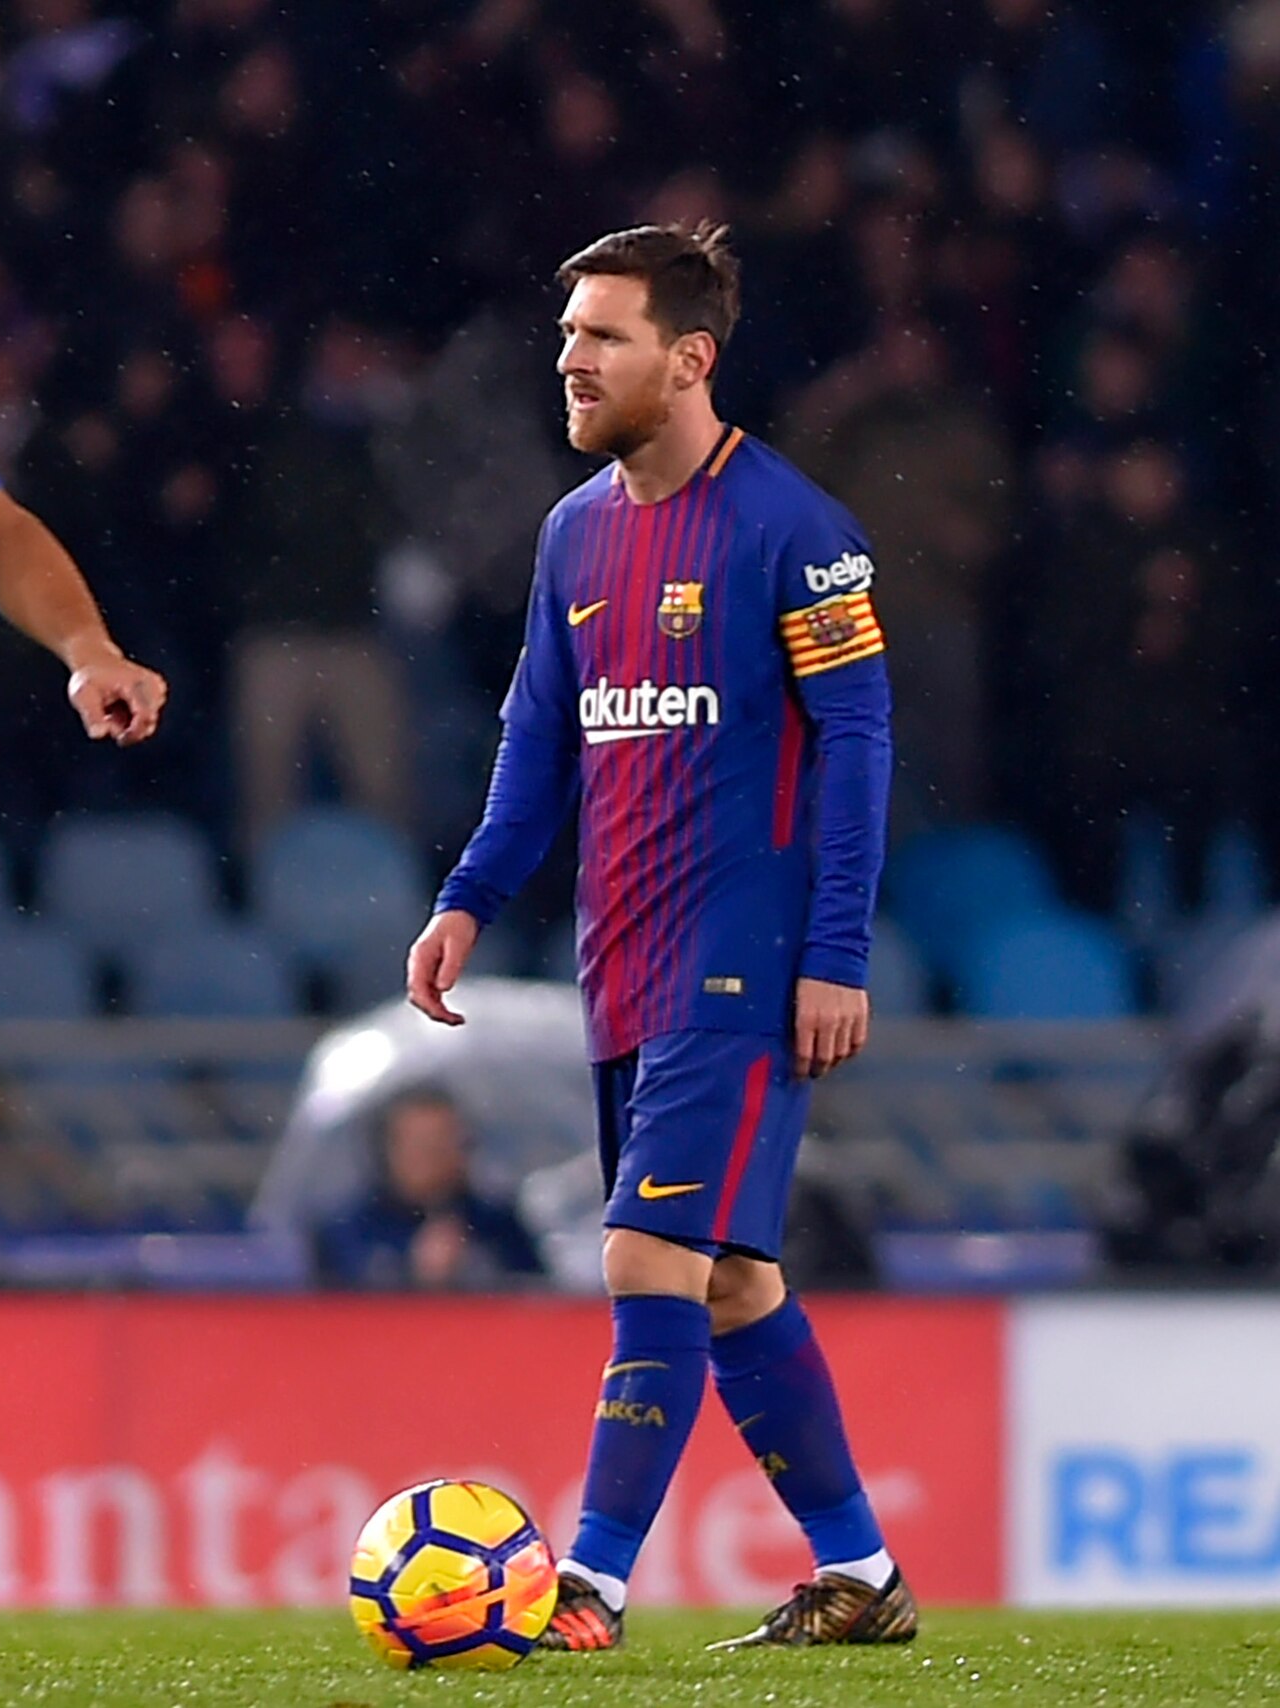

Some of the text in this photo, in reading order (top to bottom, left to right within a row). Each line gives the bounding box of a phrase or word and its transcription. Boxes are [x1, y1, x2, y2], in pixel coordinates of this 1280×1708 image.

[579, 676, 718, 728] akuten
[594, 1399, 665, 1427] ARÇA
[1050, 1445, 1280, 1574] RE
